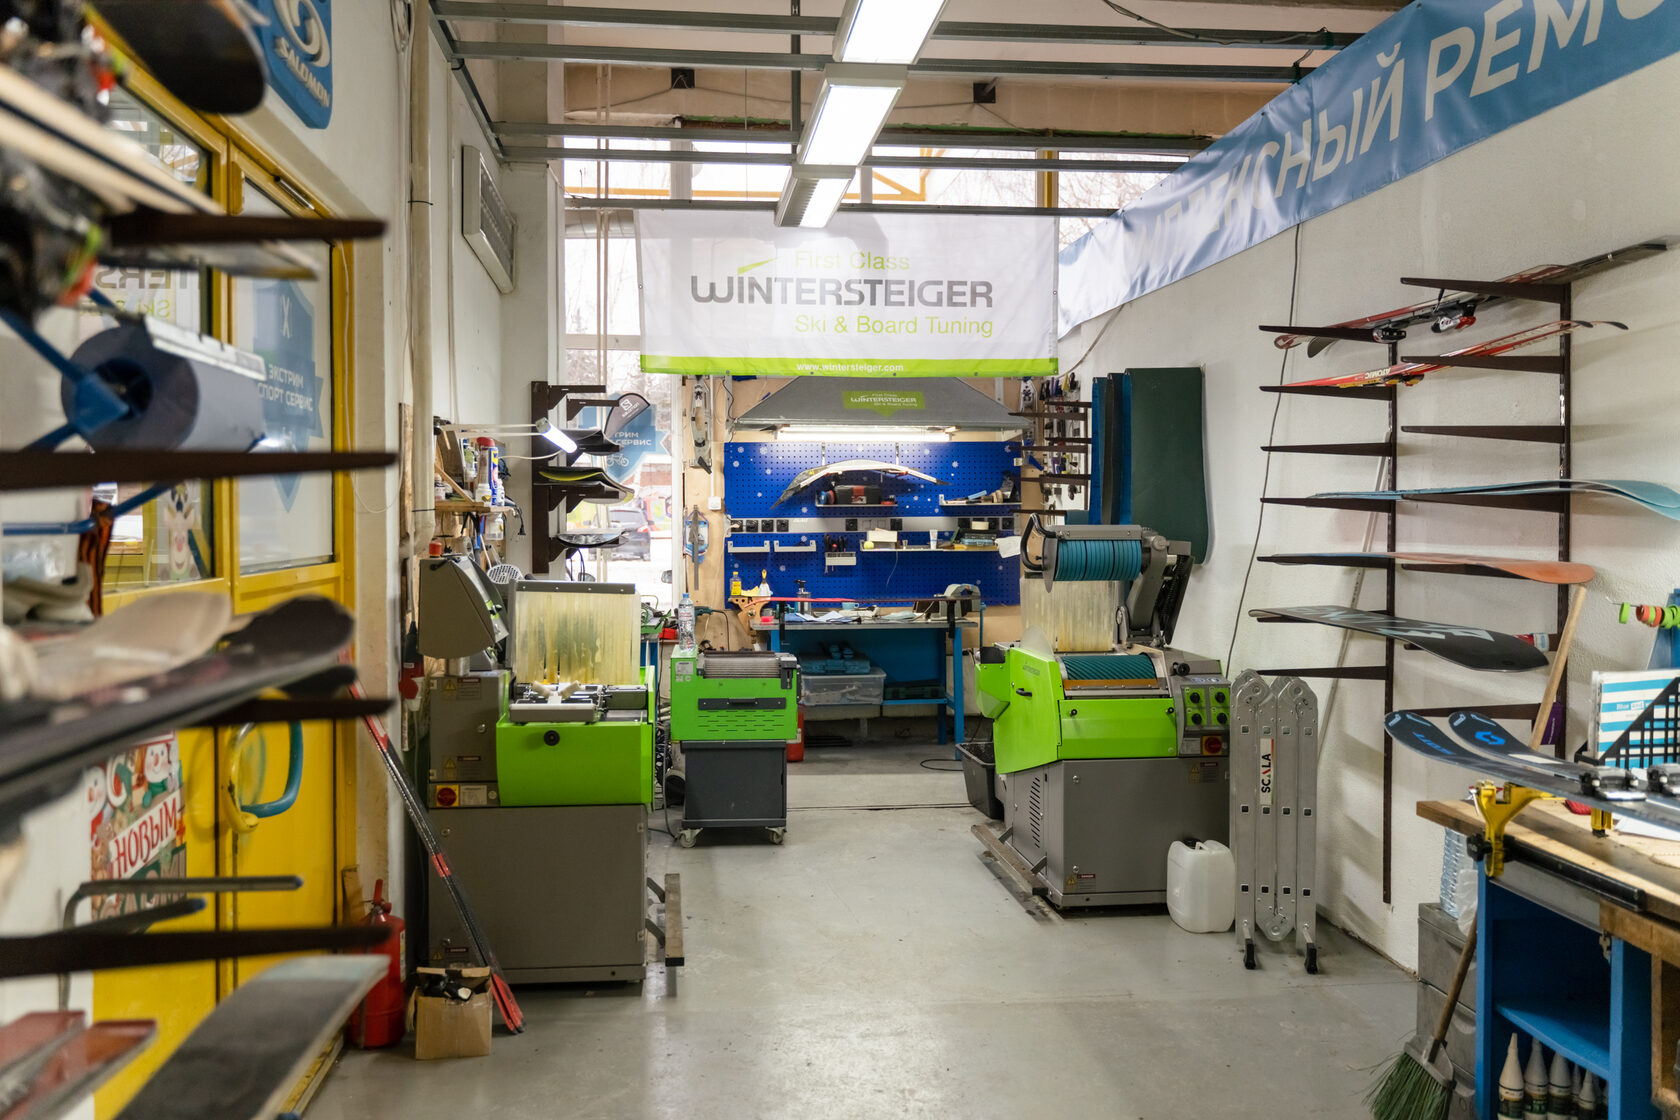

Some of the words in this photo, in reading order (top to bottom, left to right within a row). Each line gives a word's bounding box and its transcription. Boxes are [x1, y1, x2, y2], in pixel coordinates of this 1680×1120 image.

[275, 37, 330, 108] SALOMON
[1425, 0, 1672, 122] РЕМ
[795, 251, 841, 270] First
[849, 251, 910, 270] Class
[690, 275, 993, 308] WINTERSTEIGER
[794, 314, 827, 334] Ski
[833, 316, 848, 334] &
[856, 315, 918, 334] Board
[925, 317, 993, 338] Tuning
[268, 363, 304, 389] ЭКСТРИМ
[796, 363, 904, 374] www.wintersteiger.com
[1365, 367, 1391, 379] ATOMIC
[285, 391, 314, 412] СЕРВИС
[1261, 753, 1272, 793] SCALA
[114, 797, 177, 881] НОВЫМ
